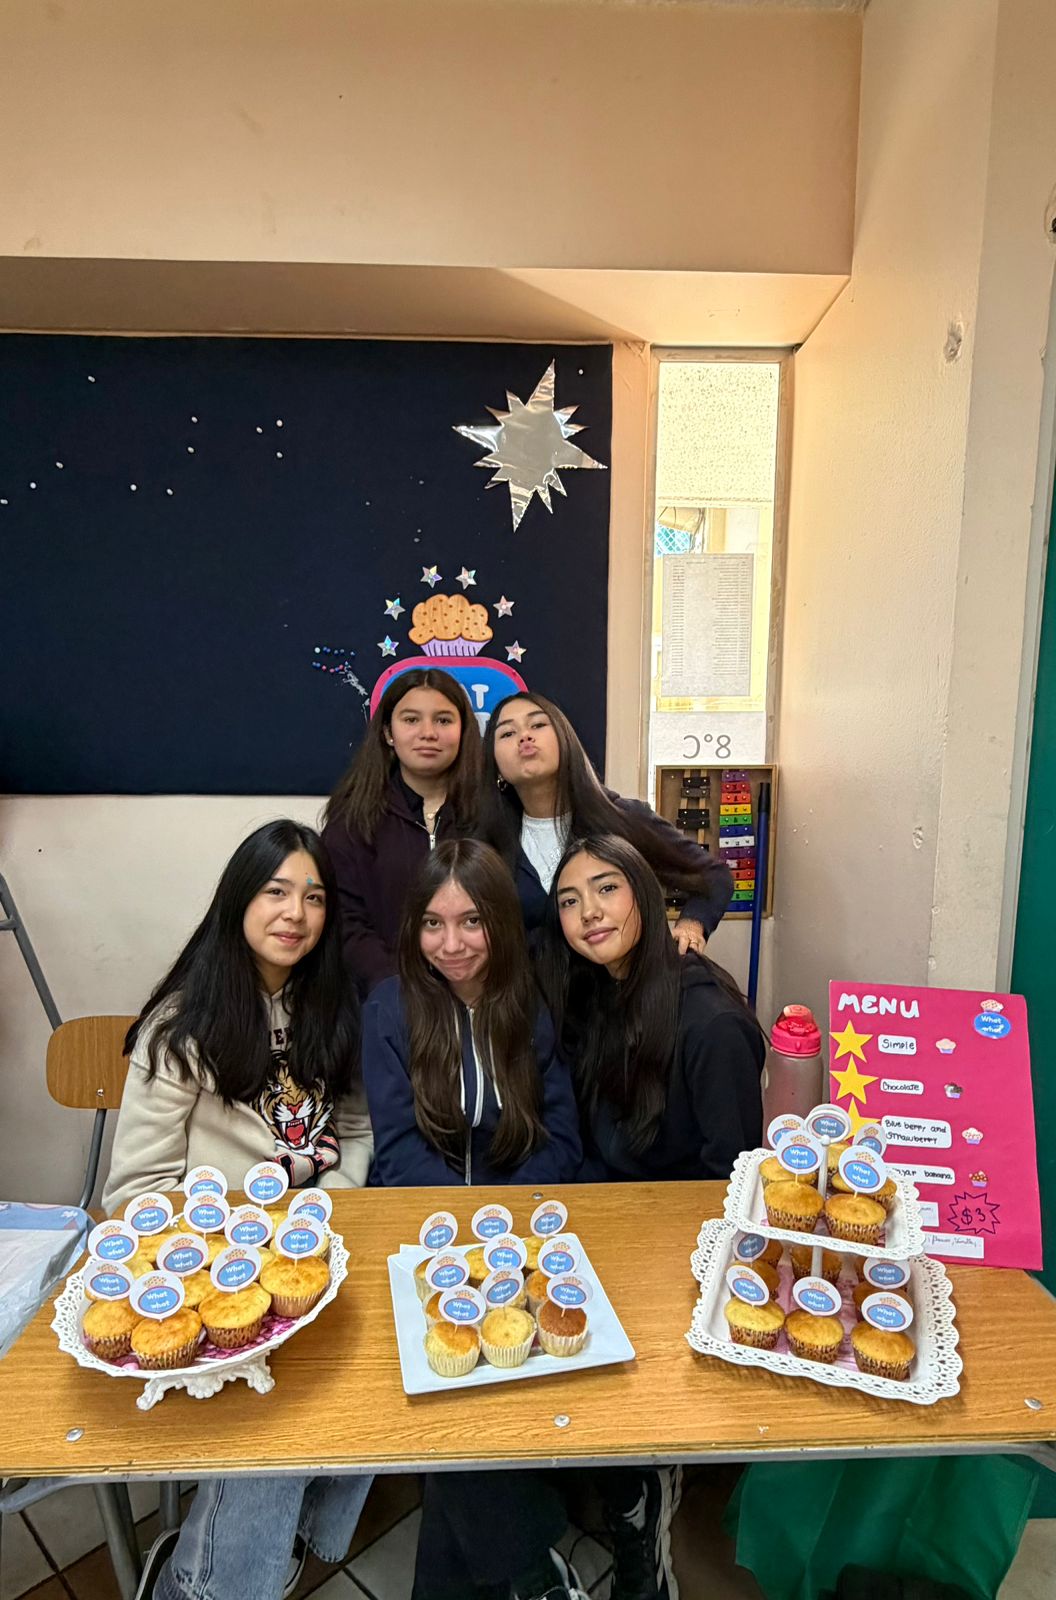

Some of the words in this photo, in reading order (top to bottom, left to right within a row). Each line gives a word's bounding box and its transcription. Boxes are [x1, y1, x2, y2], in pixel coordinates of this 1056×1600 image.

[837, 992, 920, 1018] MENU
[981, 1015, 1001, 1024] What
[882, 1039, 916, 1051] Simple
[882, 1082, 920, 1091] Chocolate
[885, 1119, 902, 1127] Blue
[904, 1122, 926, 1132] berry
[853, 1165, 870, 1176] What
[852, 1174, 868, 1184] what
[197, 1183, 214, 1191] What
[140, 1211, 158, 1219] What
[142, 1219, 159, 1227] what
[104, 1239, 123, 1248] What
[108, 1248, 125, 1256] what
[172, 1252, 192, 1260] What
[175, 1260, 193, 1268] what
[226, 1264, 246, 1273] What
[228, 1273, 246, 1282] what
[561, 1286, 577, 1295] What
[740, 1282, 755, 1290] What
[146, 1291, 168, 1300] What
[808, 1292, 826, 1302] What
[151, 1300, 171, 1309] what
[808, 1300, 824, 1308] what
[877, 1308, 896, 1317] What
[876, 1316, 894, 1324] what
